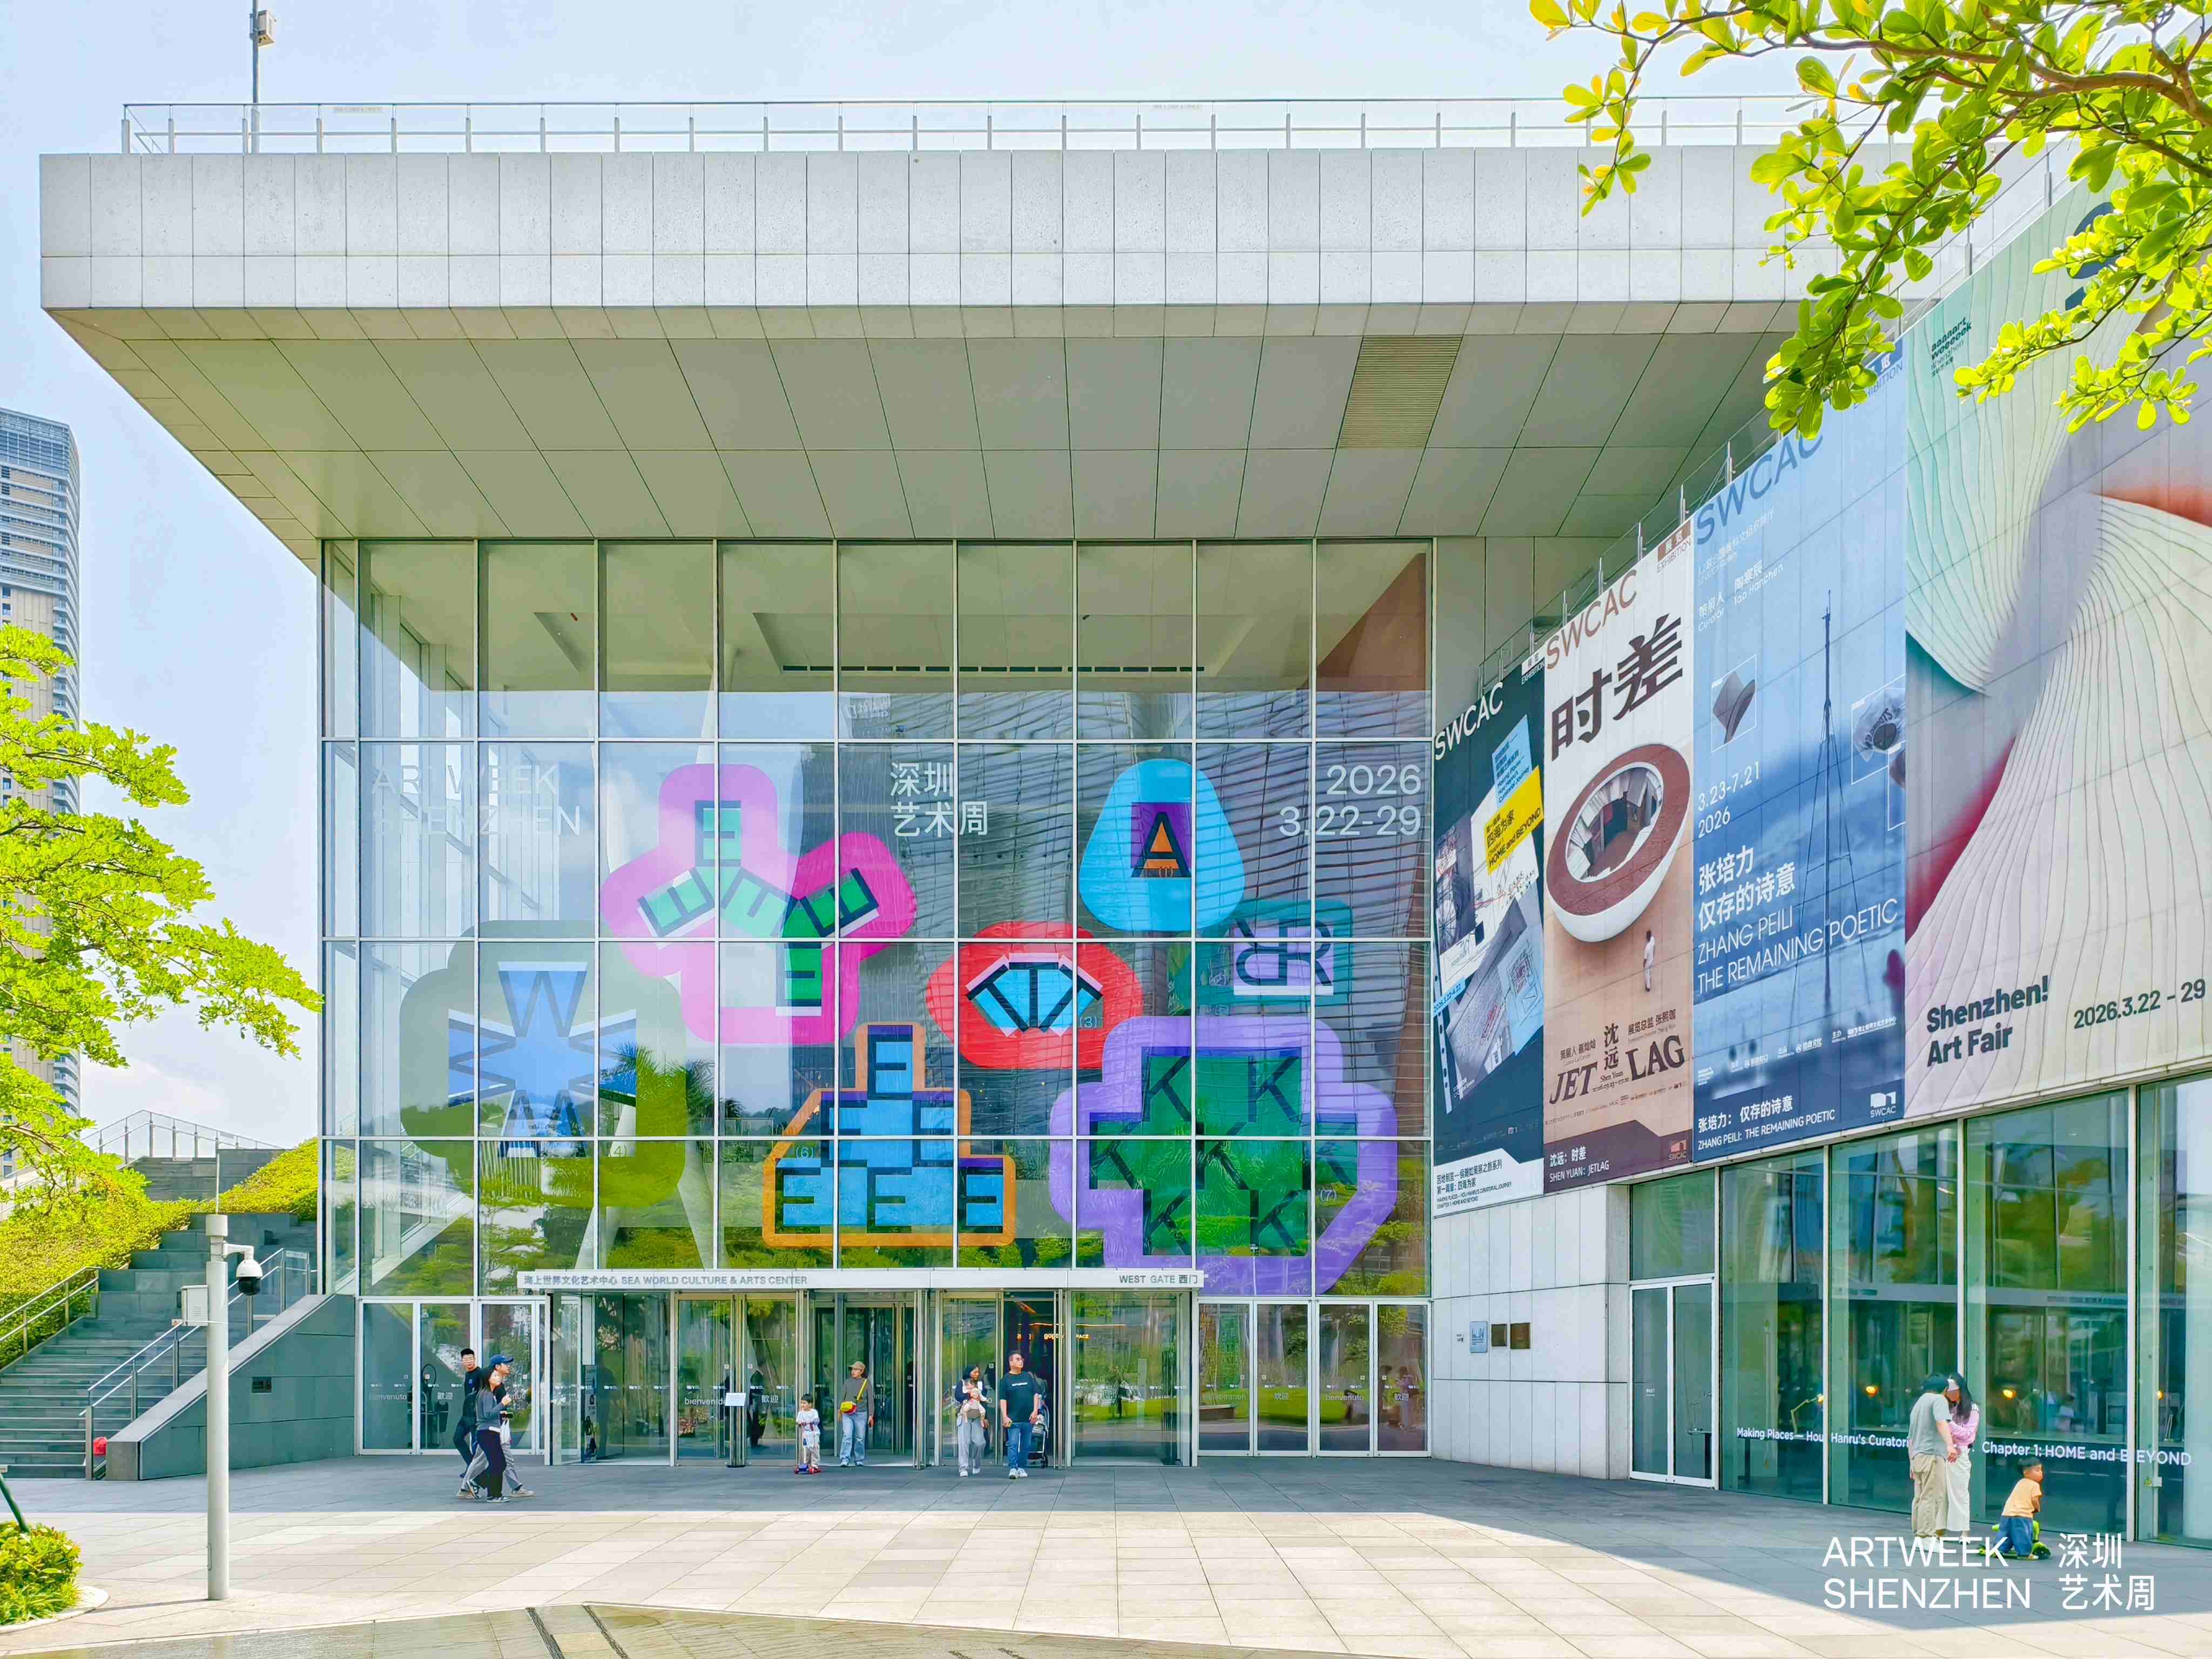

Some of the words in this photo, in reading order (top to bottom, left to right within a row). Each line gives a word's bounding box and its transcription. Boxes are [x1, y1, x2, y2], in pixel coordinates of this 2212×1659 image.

[1547, 570, 1637, 669] SWCAC
[1552, 613, 1683, 761] 时差
[1435, 682, 1503, 760] SWCAC
[372, 765, 558, 794] ARWEEK
[890, 762, 955, 797] 深圳
[1327, 765, 1421, 795] 2026
[1698, 761, 1760, 812] 3.23-7.21
[375, 805, 581, 835] ENZEN
[892, 801, 988, 838] 艺术周
[1279, 806, 1421, 836] 3.22-29
[1489, 844, 1506, 867] HOME
[1516, 808, 1541, 839] BEYOND
[1698, 806, 1731, 839] 2026
[1699, 845, 1754, 895] 张培力
[1699, 861, 1796, 933] 仅存的诗意
[1698, 924, 1753, 965] ZHANG
[1758, 905, 1793, 941] PEILI
[1698, 967, 1723, 994] THE
[1728, 927, 1826, 983] REMAINING
[1829, 898, 1898, 946] POETIC
[1080, 1015, 1097, 1028] (3)
[1926, 975, 2049, 1033] Shenzhen!
[2074, 990, 2161, 1029] 2026.3.22
[2181, 979, 2206, 1003] 29
[1604, 1023, 1619, 1070] 沈远
[1926, 1035, 1962, 1067] Art
[1967, 1022, 2013, 1056] Fair
[1549, 1061, 1598, 1104] JET
[1625, 1035, 1685, 1081] LAG
[1698, 1112, 1732, 1133] 张培力：
[1739, 1095, 1793, 1123] 仅存的诗意
[1698, 1136, 1722, 1150] ZHANG
[1723, 1132, 1742, 1145] PEILI:
[1744, 1128, 1760, 1139] THE
[1761, 1117, 1804, 1136] REMAINING
[1805, 1109, 1836, 1125] POETIC
[1870, 1105, 1897, 1118] SWCAC
[795, 1145, 814, 1159] (6)
[1549, 1171, 1565, 1183] SHEN
[1588, 1160, 1610, 1176] JETLAG
[524, 1275, 618, 1285] 海上世界文化艺术中心
[622, 1276, 640, 1285] SEA
[643, 1276, 678, 1285] WORLD
[682, 1276, 727, 1285] CULTURE
[730, 1276, 737, 1285] &
[740, 1276, 766, 1285] ARTS
[768, 1276, 807, 1285] CENTER
[1120, 1275, 1145, 1283] WEST
[1150, 1275, 1175, 1283] GATE
[1179, 1275, 1197, 1284] 西门
[1737, 1427, 1765, 1439] Making
[1806, 1431, 1824, 1442] Hou
[1831, 1433, 1866, 1445] Hanru's
[1869, 1435, 1910, 1448] Curatori
[1982, 1441, 2030, 1457] Chapter
[2034, 1444, 2042, 1456] 1:
[2046, 1445, 2086, 1459] HOME
[2090, 1448, 2115, 1461] and
[2120, 1449, 2191, 1466] BEYOND
